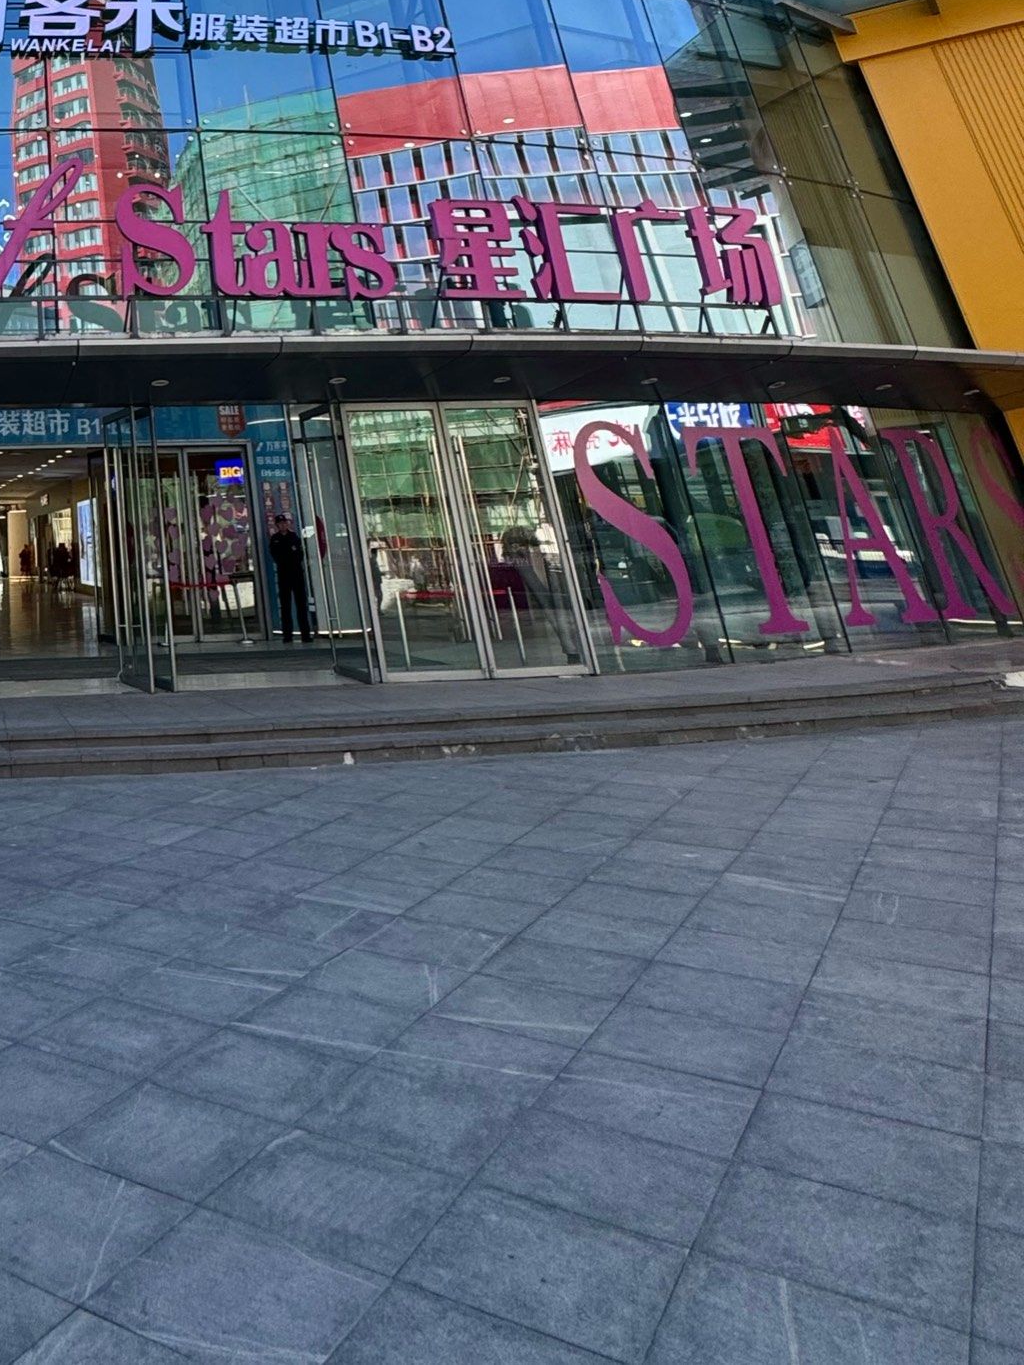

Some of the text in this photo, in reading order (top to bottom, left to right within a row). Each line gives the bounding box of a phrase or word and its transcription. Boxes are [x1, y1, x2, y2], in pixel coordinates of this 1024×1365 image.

[11, 37, 122, 53] WANKELAI
[115, 183, 399, 301] Stars
[427, 195, 783, 308] 星汇广场
[219, 406, 239, 415] SALE
